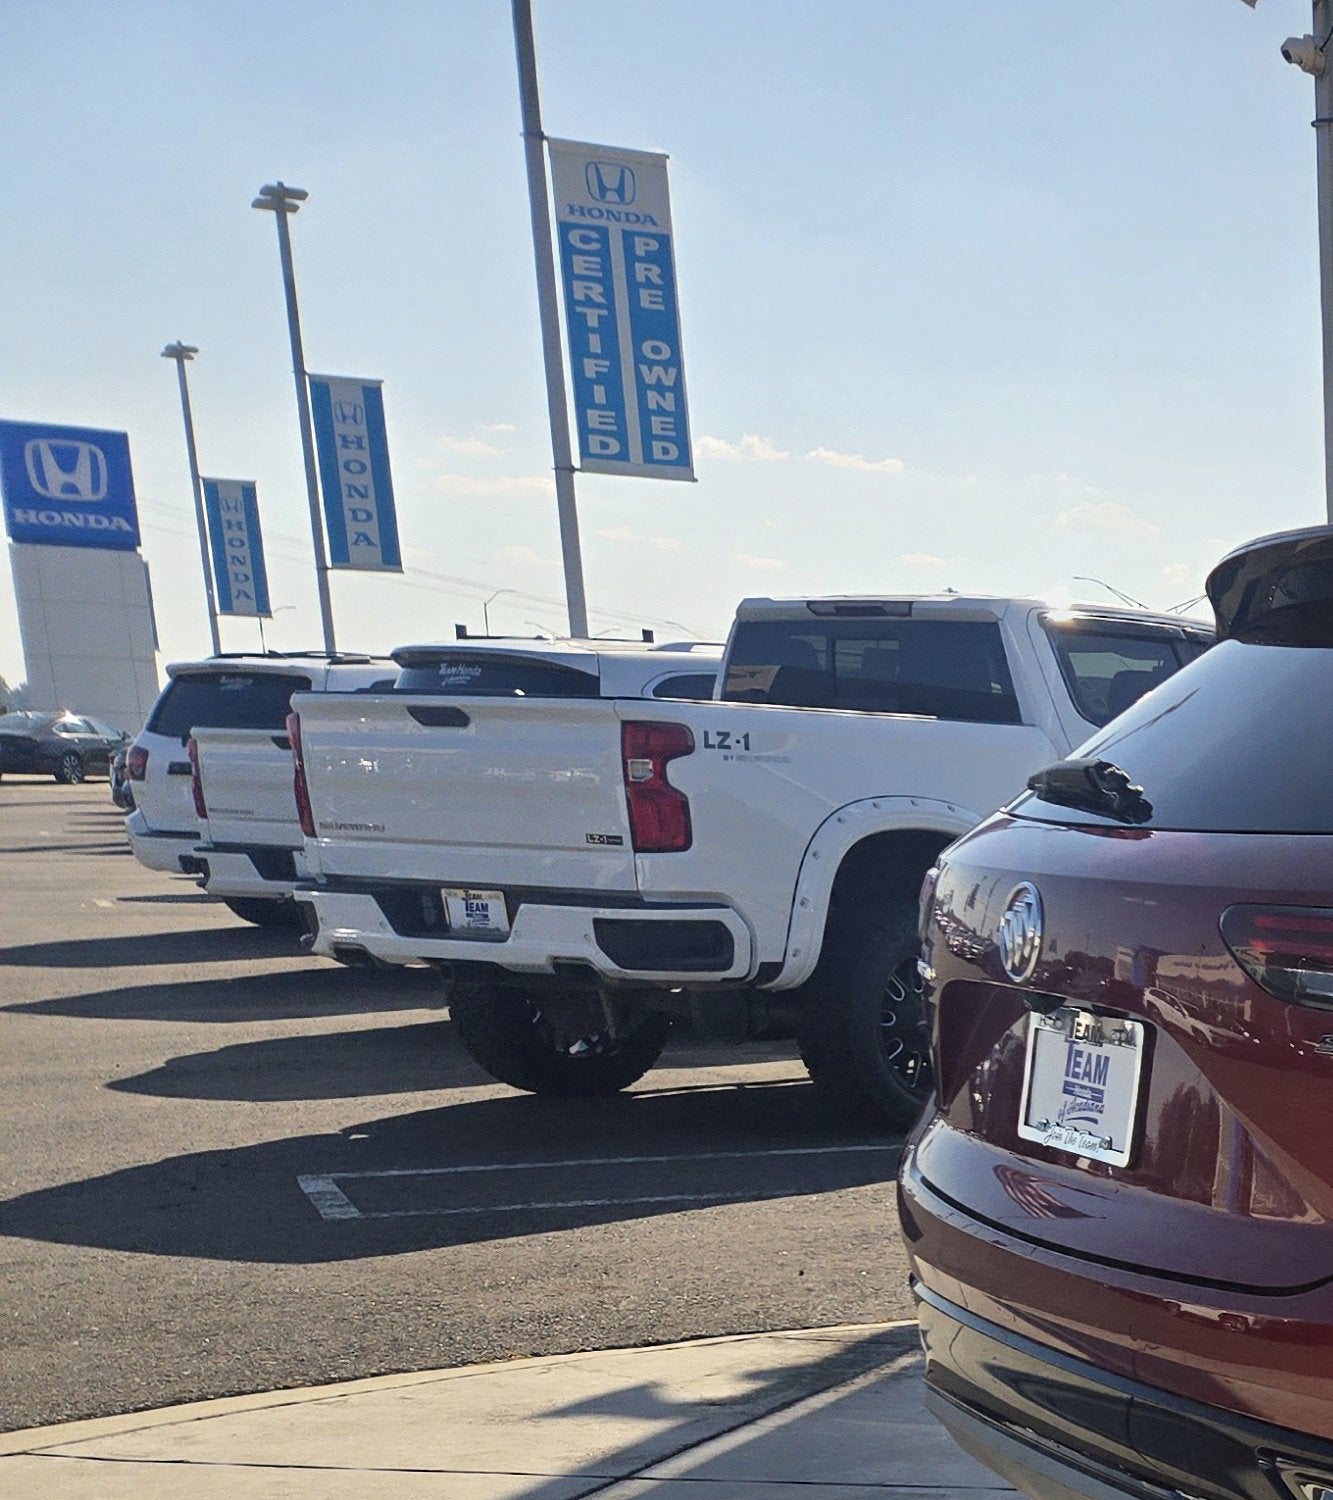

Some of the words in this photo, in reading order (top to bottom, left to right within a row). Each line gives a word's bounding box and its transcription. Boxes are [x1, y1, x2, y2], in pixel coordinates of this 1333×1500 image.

[567, 204, 658, 226] HONDA
[633, 236, 665, 311] PRE
[567, 228, 621, 456] CERTIFIED
[639, 339, 679, 461] OWNED
[12, 507, 134, 533] HONDA
[338, 434, 378, 548] HONDA
[226, 519, 254, 601] HONDA
[461, 897, 489, 913] TEAM
[1065, 1037, 1110, 1087] TEAM
